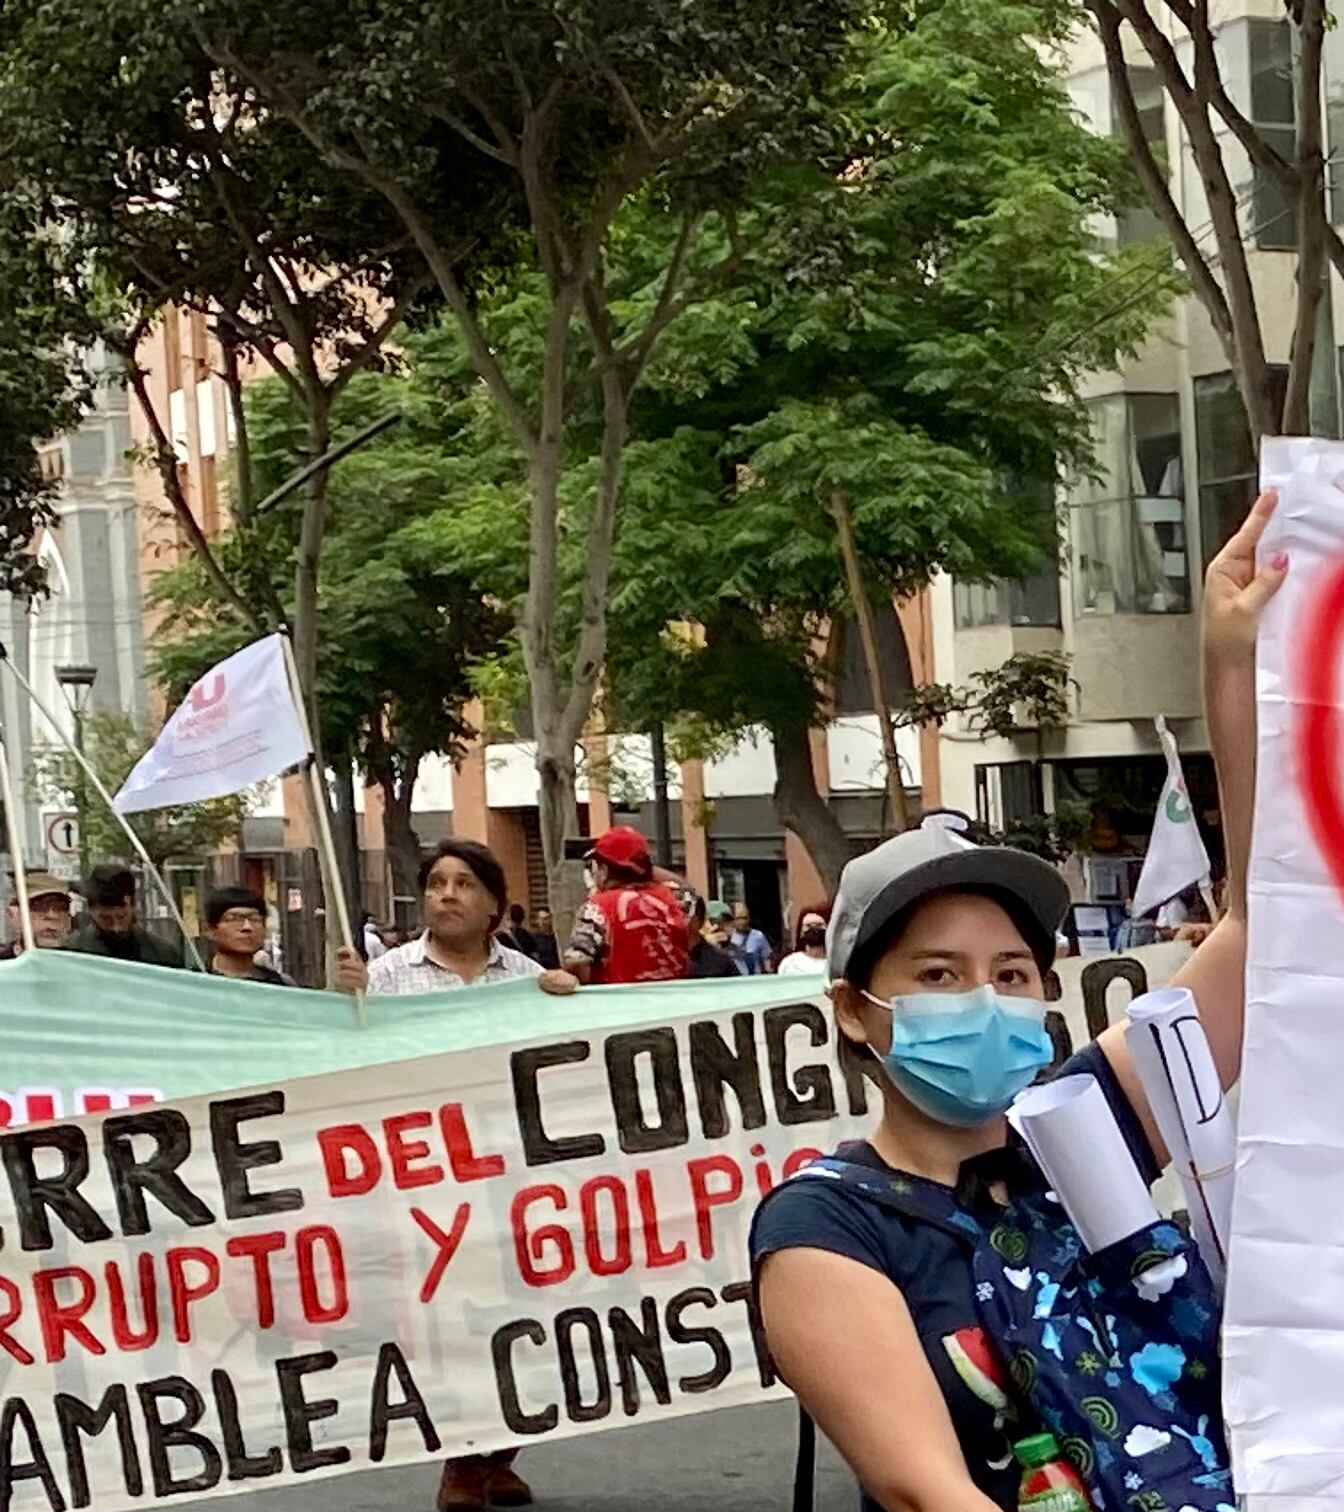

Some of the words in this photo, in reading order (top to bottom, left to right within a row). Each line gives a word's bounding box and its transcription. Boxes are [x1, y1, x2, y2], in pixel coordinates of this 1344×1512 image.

[0, 1091, 304, 1252] RRE
[317, 1102, 506, 1198] DEL
[410, 1202, 471, 1304] Y
